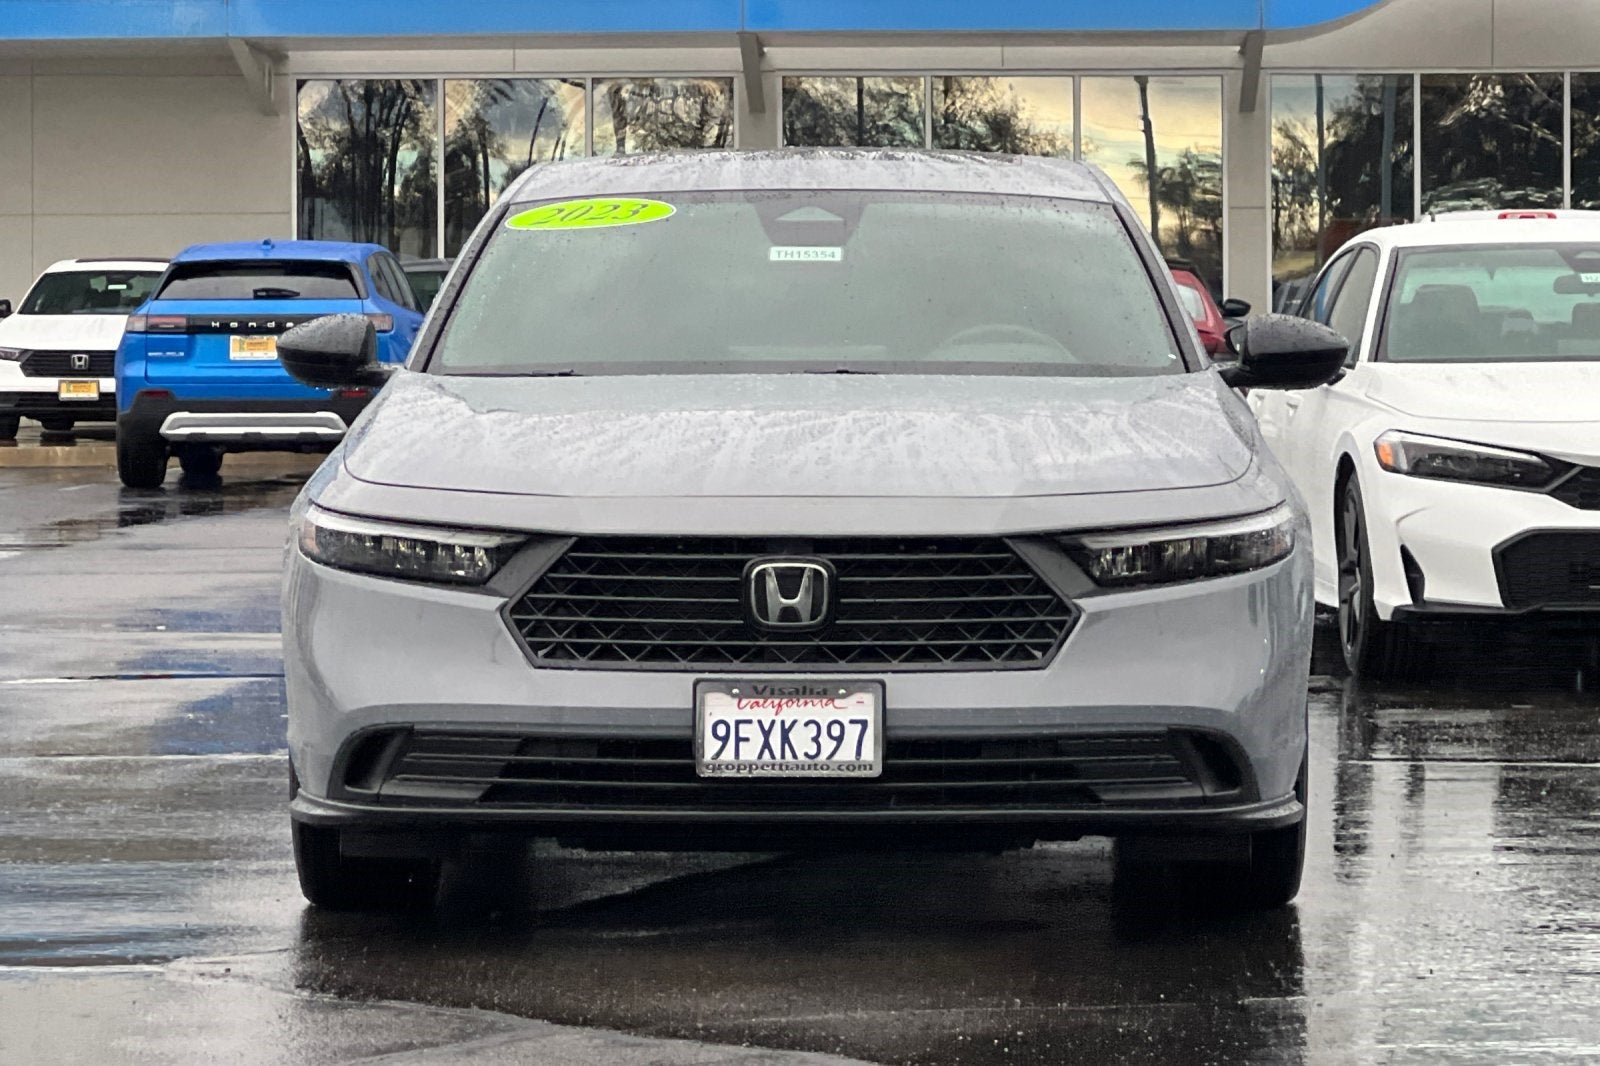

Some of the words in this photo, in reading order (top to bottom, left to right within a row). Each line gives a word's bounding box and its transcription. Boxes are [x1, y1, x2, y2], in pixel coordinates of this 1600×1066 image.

[527, 203, 649, 225] 2023
[752, 685, 829, 696] Visalia
[711, 719, 869, 760] 9FXK397
[704, 762, 874, 774] groppettiauto.com
